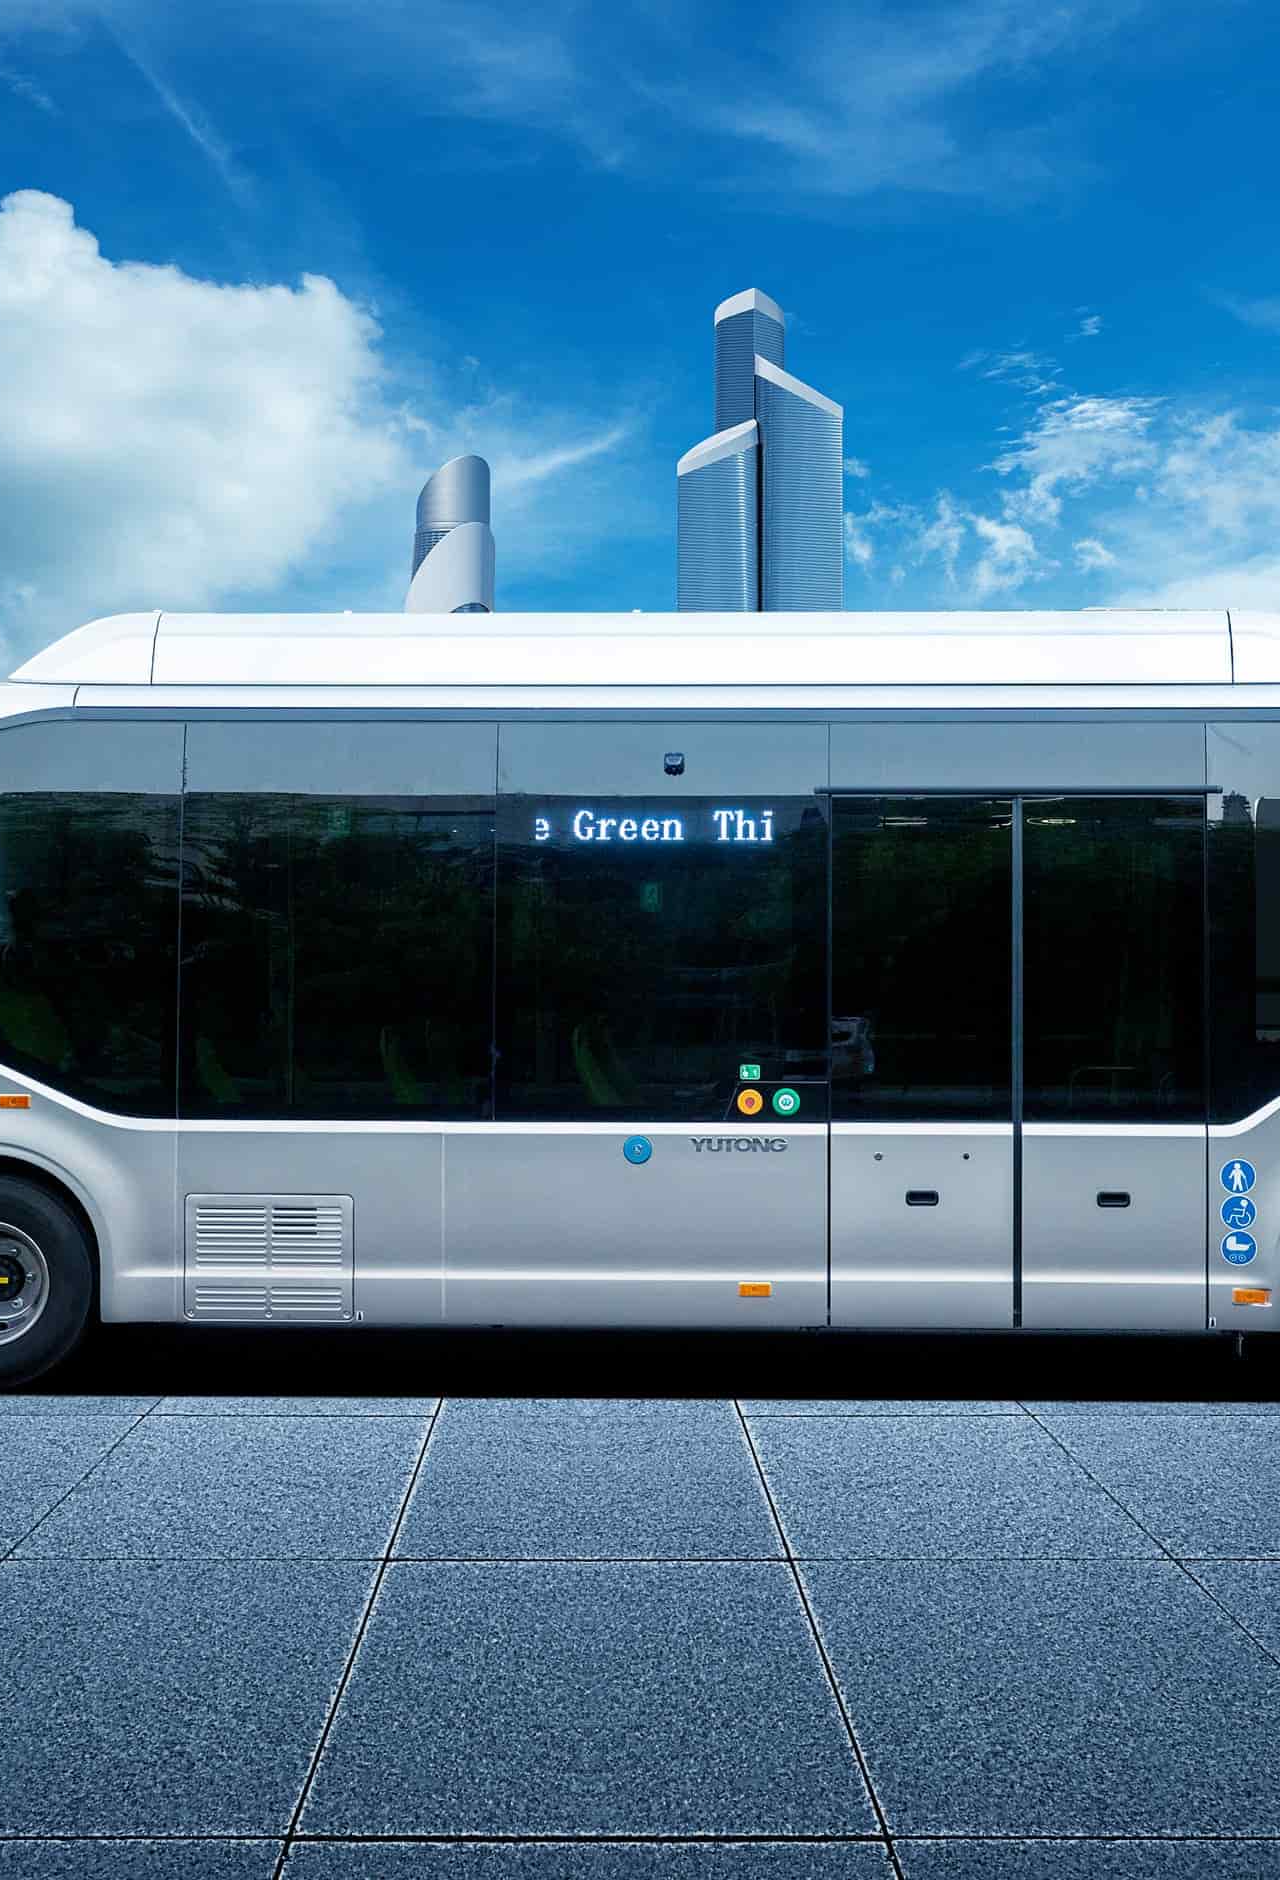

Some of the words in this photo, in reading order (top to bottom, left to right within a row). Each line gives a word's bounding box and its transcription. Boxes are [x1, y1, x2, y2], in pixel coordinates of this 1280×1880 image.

[535, 818, 550, 841] e
[573, 810, 684, 841] Green
[713, 810, 773, 841] Thi
[689, 1137, 788, 1153] YUTONG
